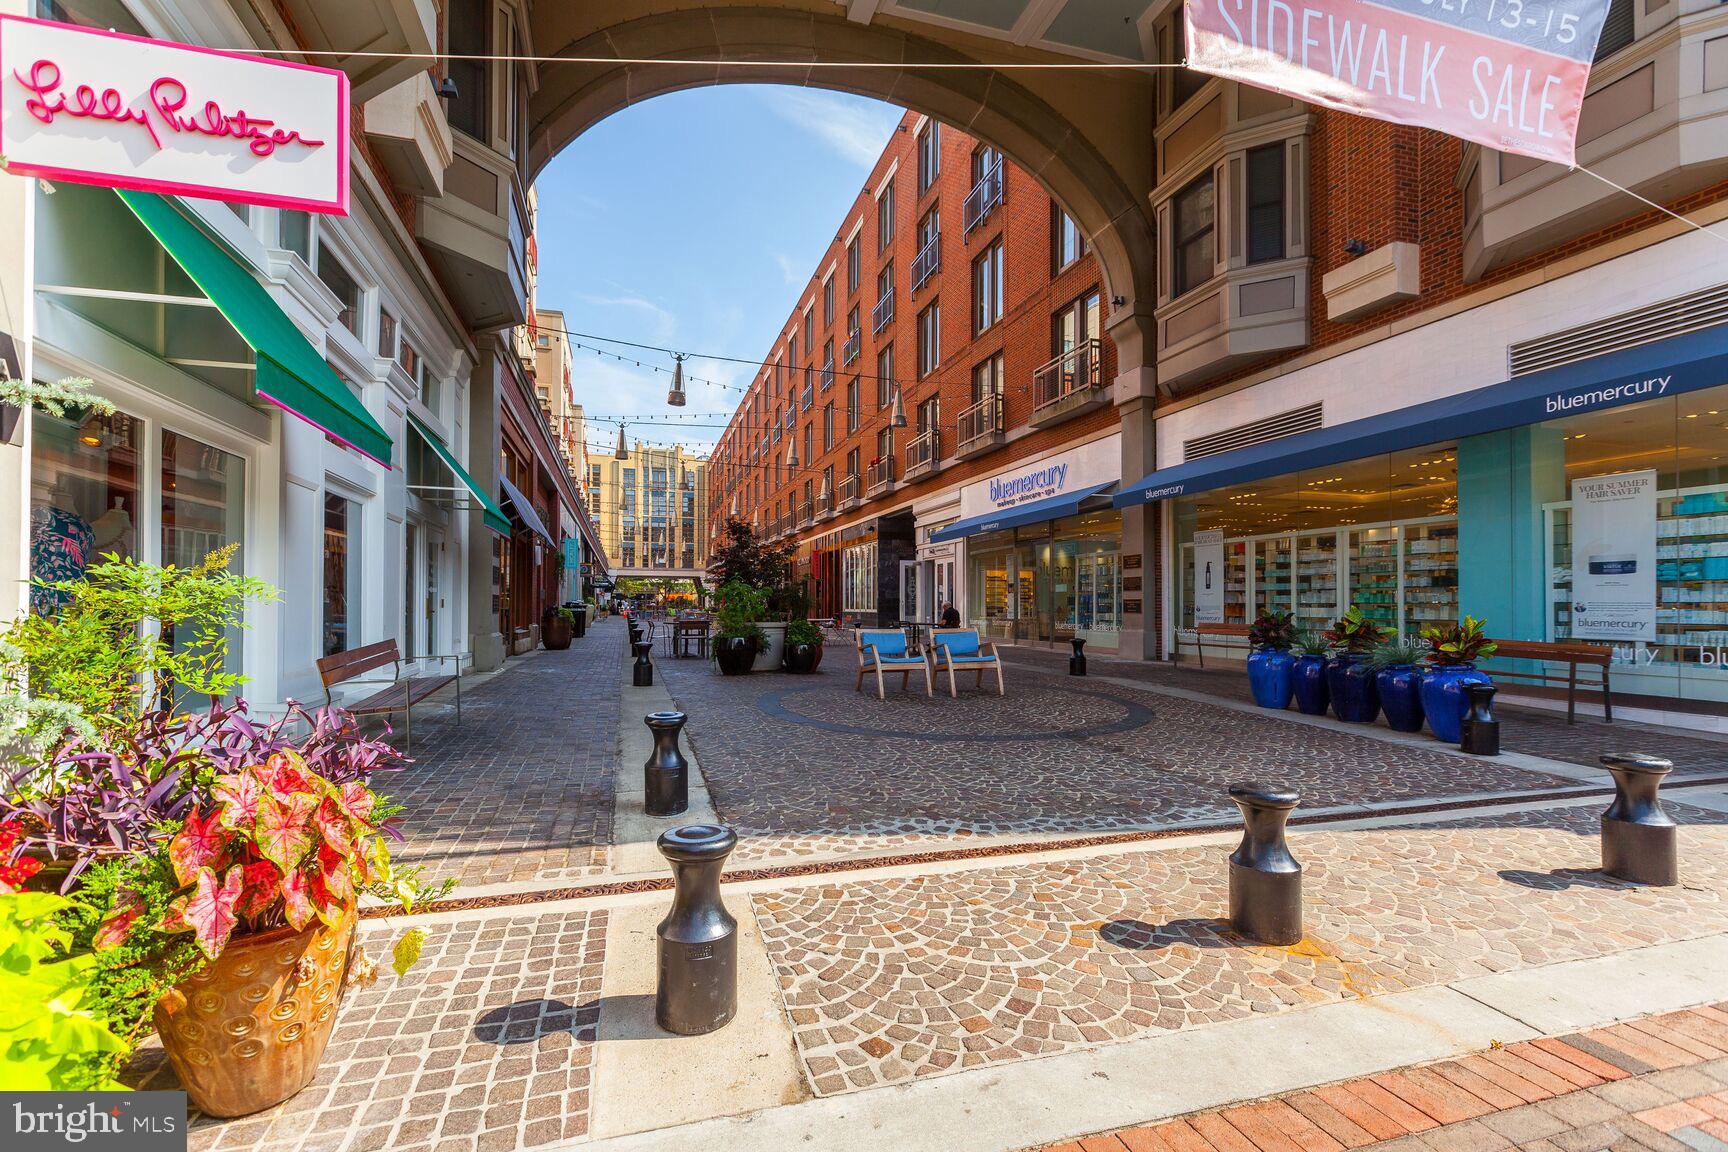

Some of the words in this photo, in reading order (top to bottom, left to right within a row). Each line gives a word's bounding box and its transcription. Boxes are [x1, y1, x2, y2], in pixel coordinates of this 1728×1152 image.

[1217, 0, 1447, 109] SIDEWALK
[1468, 55, 1562, 138] SALE
[13, 59, 162, 150] Lilly
[150, 77, 325, 156] Pulitzer
[1547, 375, 1672, 413] bluemercury
[989, 463, 1068, 502] bluemercury
[1145, 484, 1184, 499] bluemercury
[1579, 483, 1604, 493] YOUR
[1606, 478, 1649, 490] SUMMER
[1586, 490, 1609, 499] HAIR
[1610, 486, 1641, 497] SAVER
[1578, 618, 1647, 631] bluemercury
